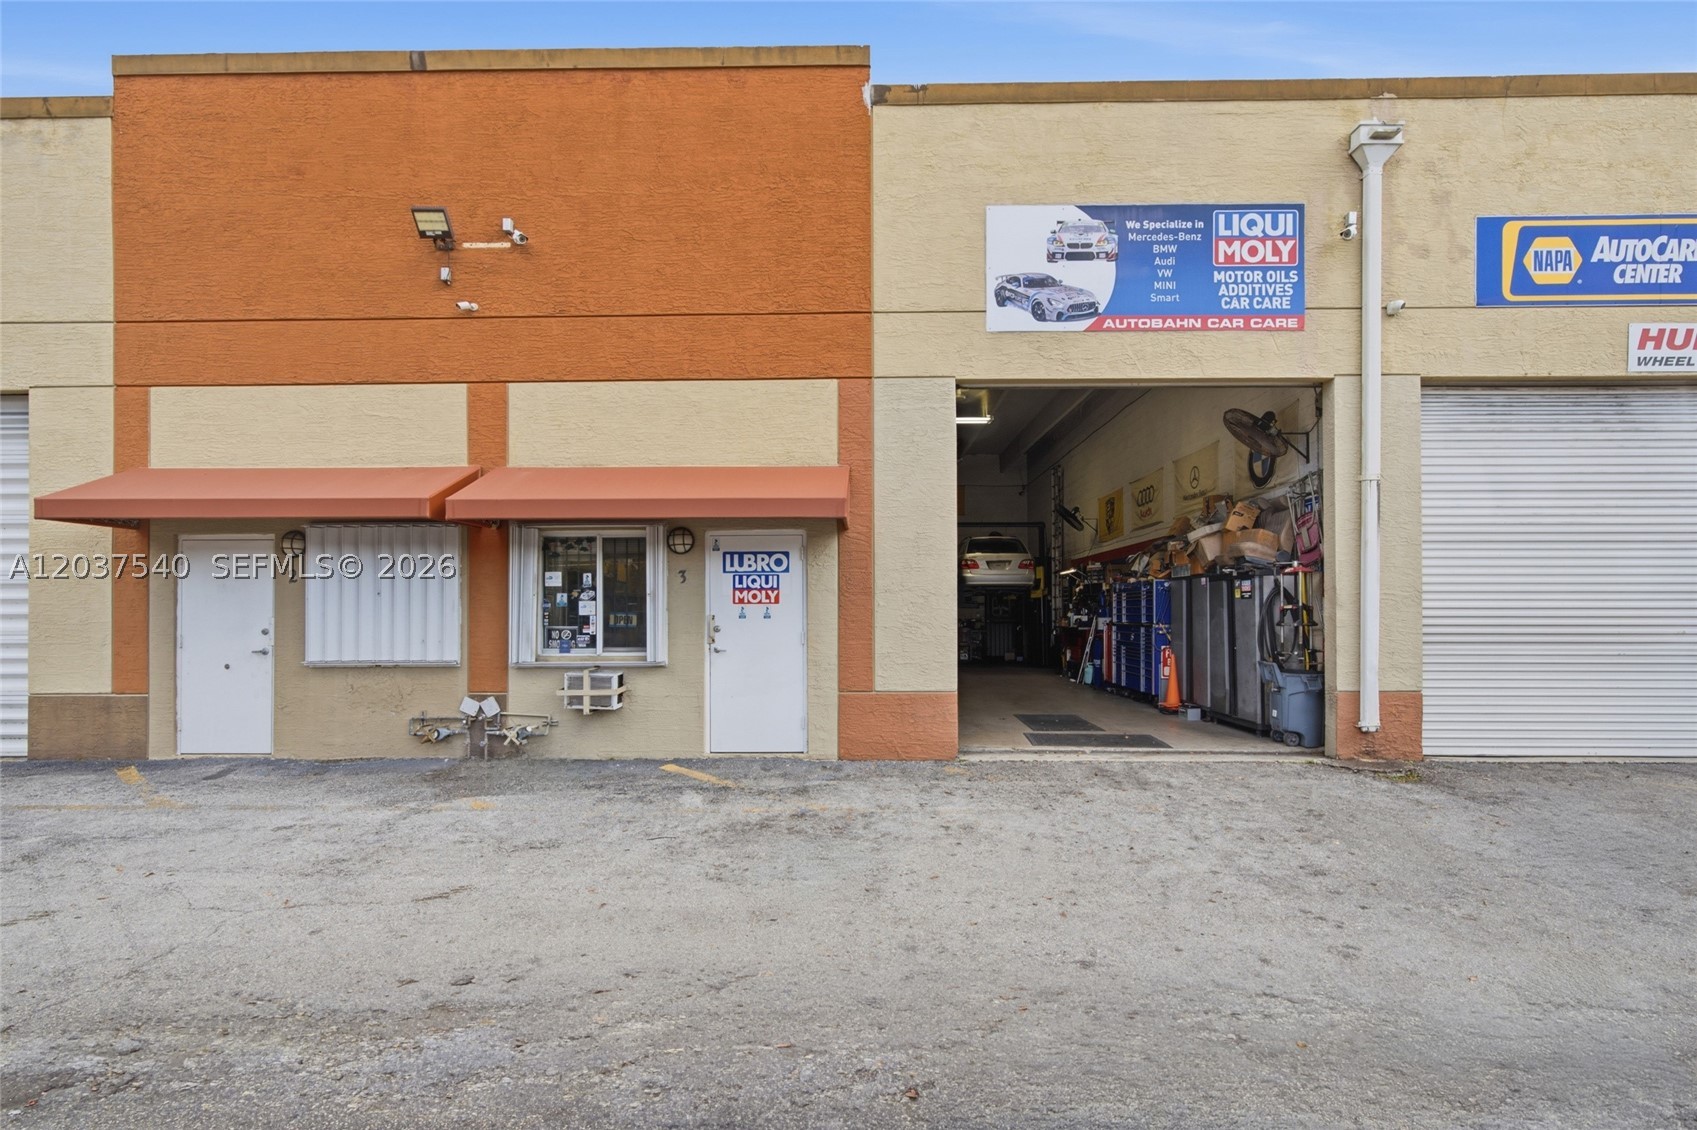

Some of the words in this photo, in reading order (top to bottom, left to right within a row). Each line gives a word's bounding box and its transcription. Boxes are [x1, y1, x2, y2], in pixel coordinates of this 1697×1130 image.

[1125, 220, 1140, 229] We
[1143, 220, 1192, 231] Specialize
[1195, 220, 1204, 229] in
[1218, 213, 1293, 237] LIQUI
[1128, 232, 1202, 241] Mercedes-Benz
[1152, 244, 1178, 253] BMW
[1218, 240, 1296, 263] MOLY
[1154, 257, 1176, 265] Audi
[1533, 250, 1573, 272] NAPA
[1157, 269, 1173, 278] VW
[1213, 270, 1263, 283] MOTOR
[1266, 270, 1299, 283] OILS
[1613, 263, 1683, 284] CENTER
[1154, 281, 1176, 290] MINI
[1218, 283, 1294, 296] ADDITIVES
[1150, 293, 1180, 302] Smart
[1221, 297, 1250, 309] CAR
[1253, 297, 1291, 309] CARE
[1103, 318, 1201, 328] AUTOBAHN
[1207, 318, 1244, 328] CAR
[1250, 318, 1298, 328] CARE
[1637, 328, 1697, 351] HU
[1637, 356, 1695, 367] WHEEL
[725, 553, 788, 572] LUBRO
[678, 569, 687, 584] 3
[734, 575, 778, 589] LIQUI
[734, 590, 779, 604] MOLY
[551, 630, 560, 640] NO
